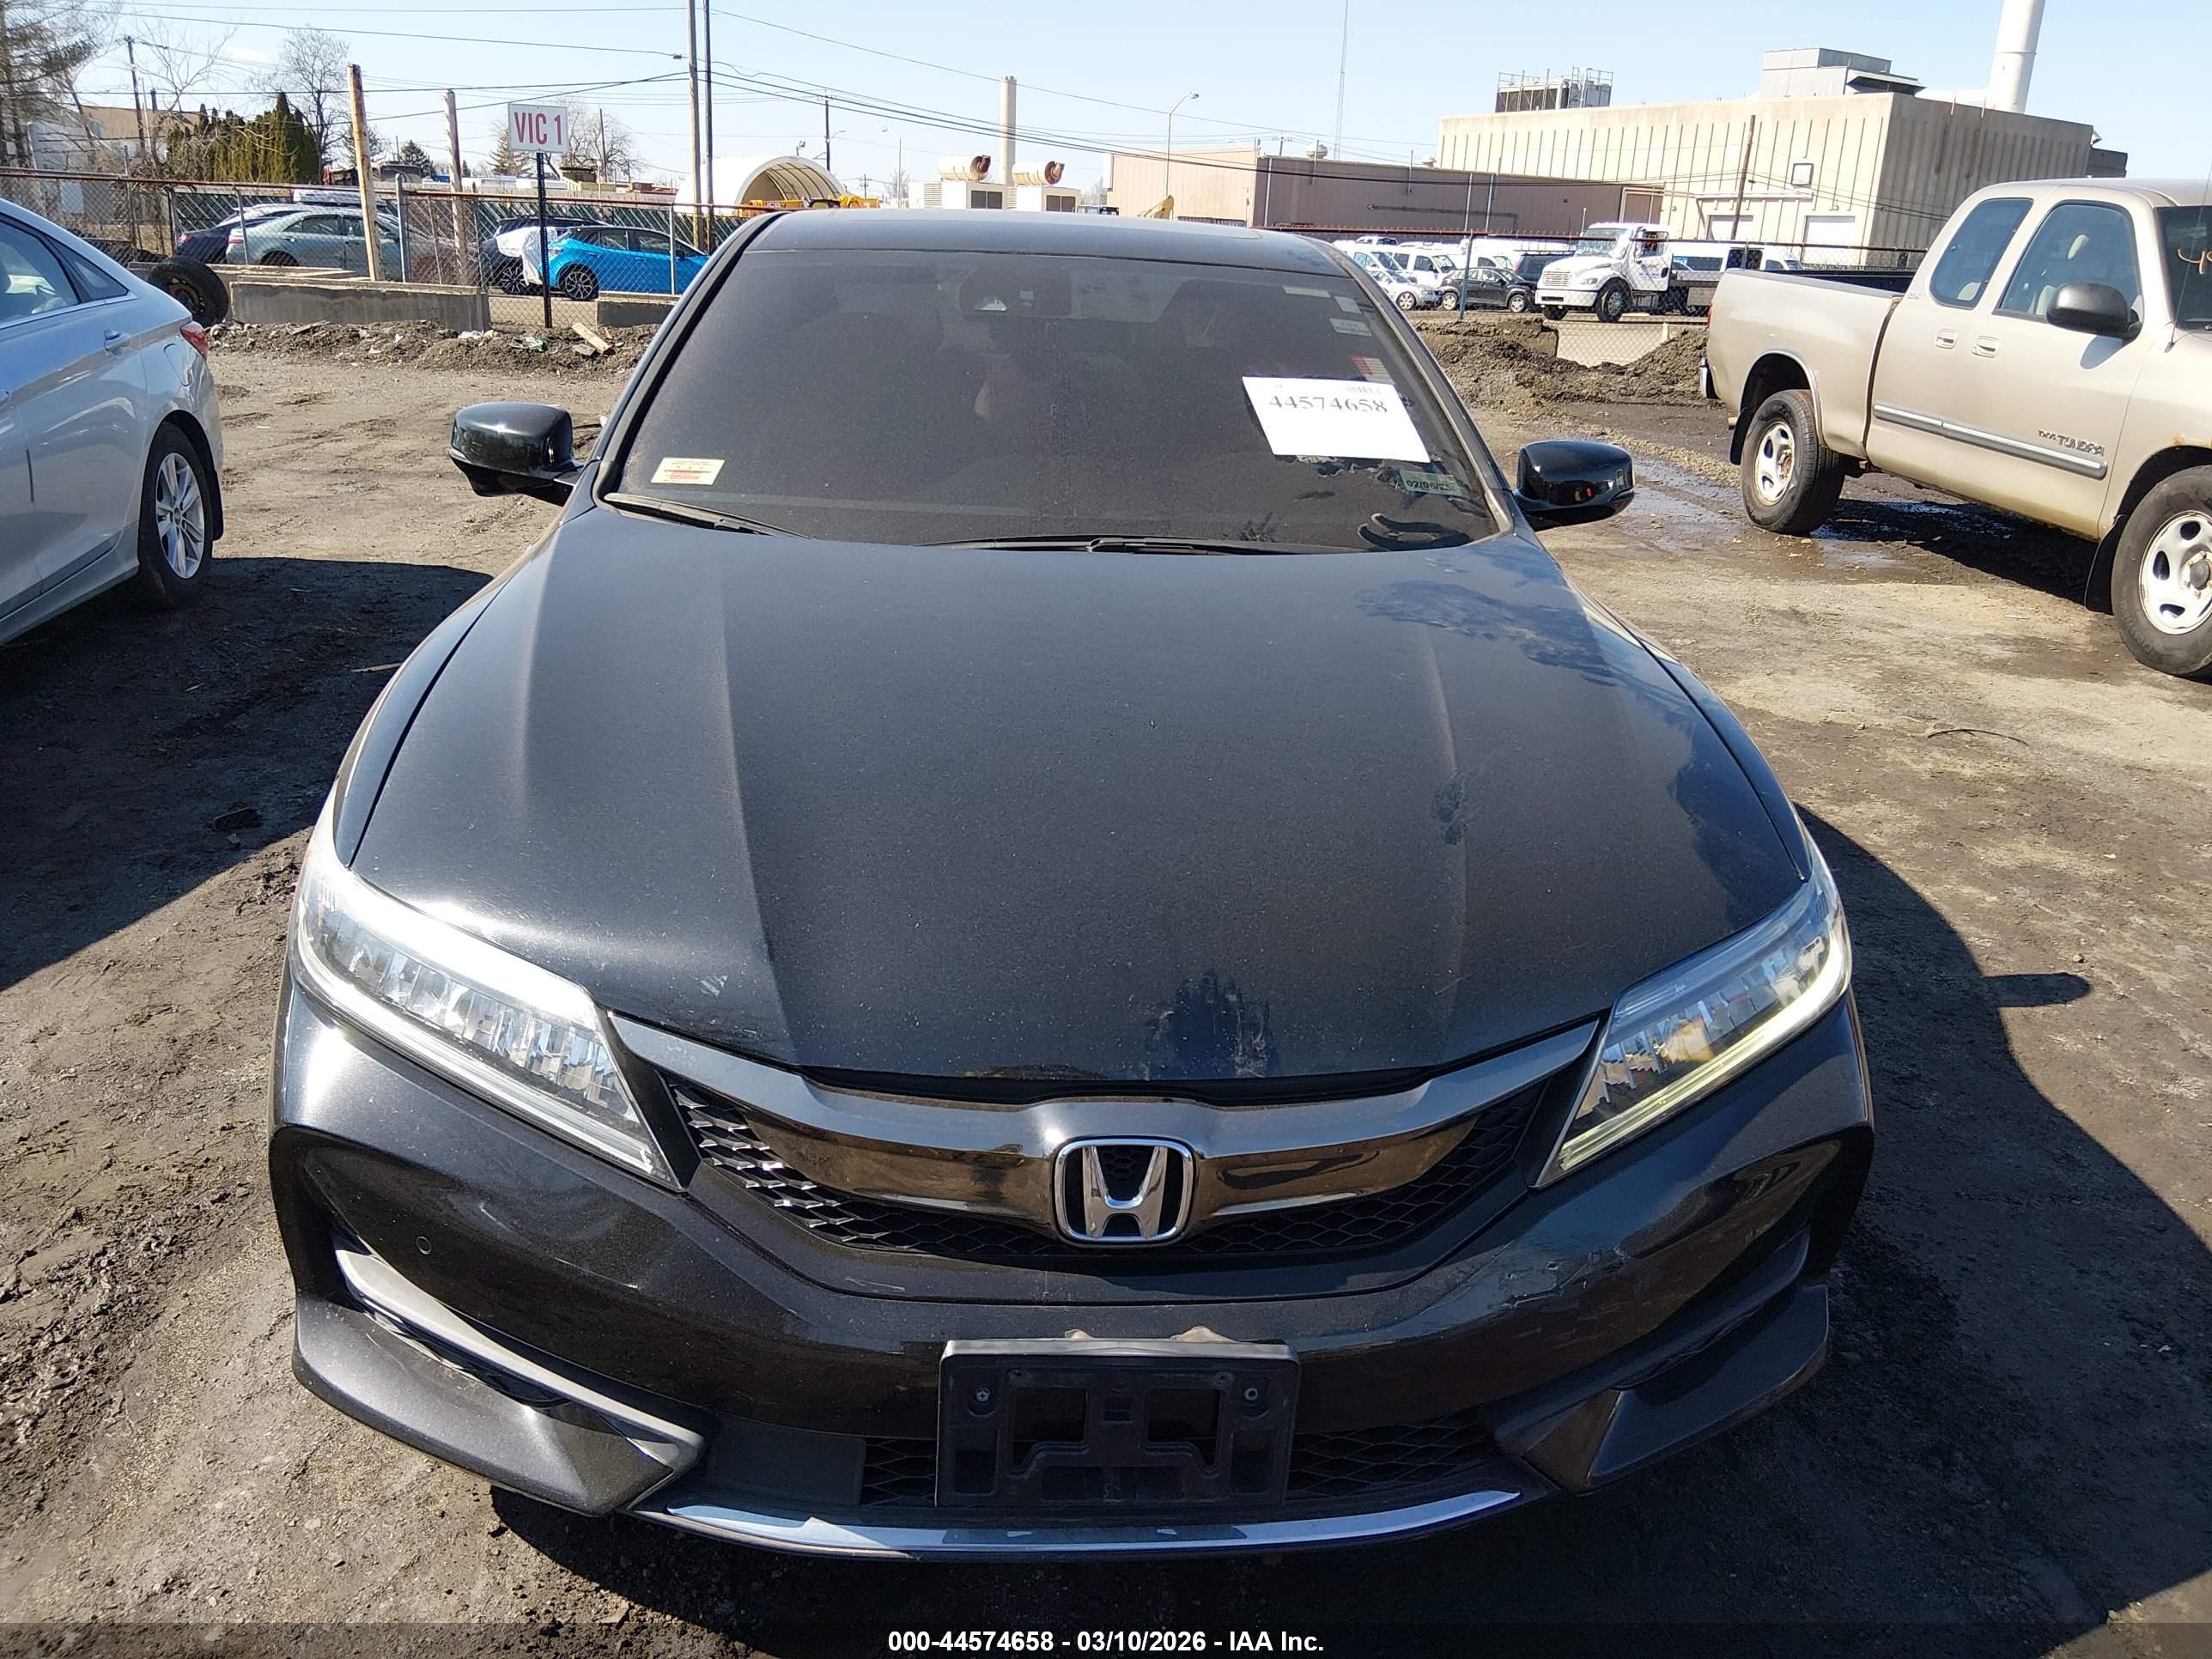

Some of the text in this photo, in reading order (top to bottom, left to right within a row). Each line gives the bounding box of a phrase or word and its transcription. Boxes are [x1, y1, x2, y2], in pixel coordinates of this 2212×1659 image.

[514, 112, 562, 145] VIC 1
[1269, 395, 1388, 413] 44574658
[2057, 434, 2106, 457] TUNDRA
